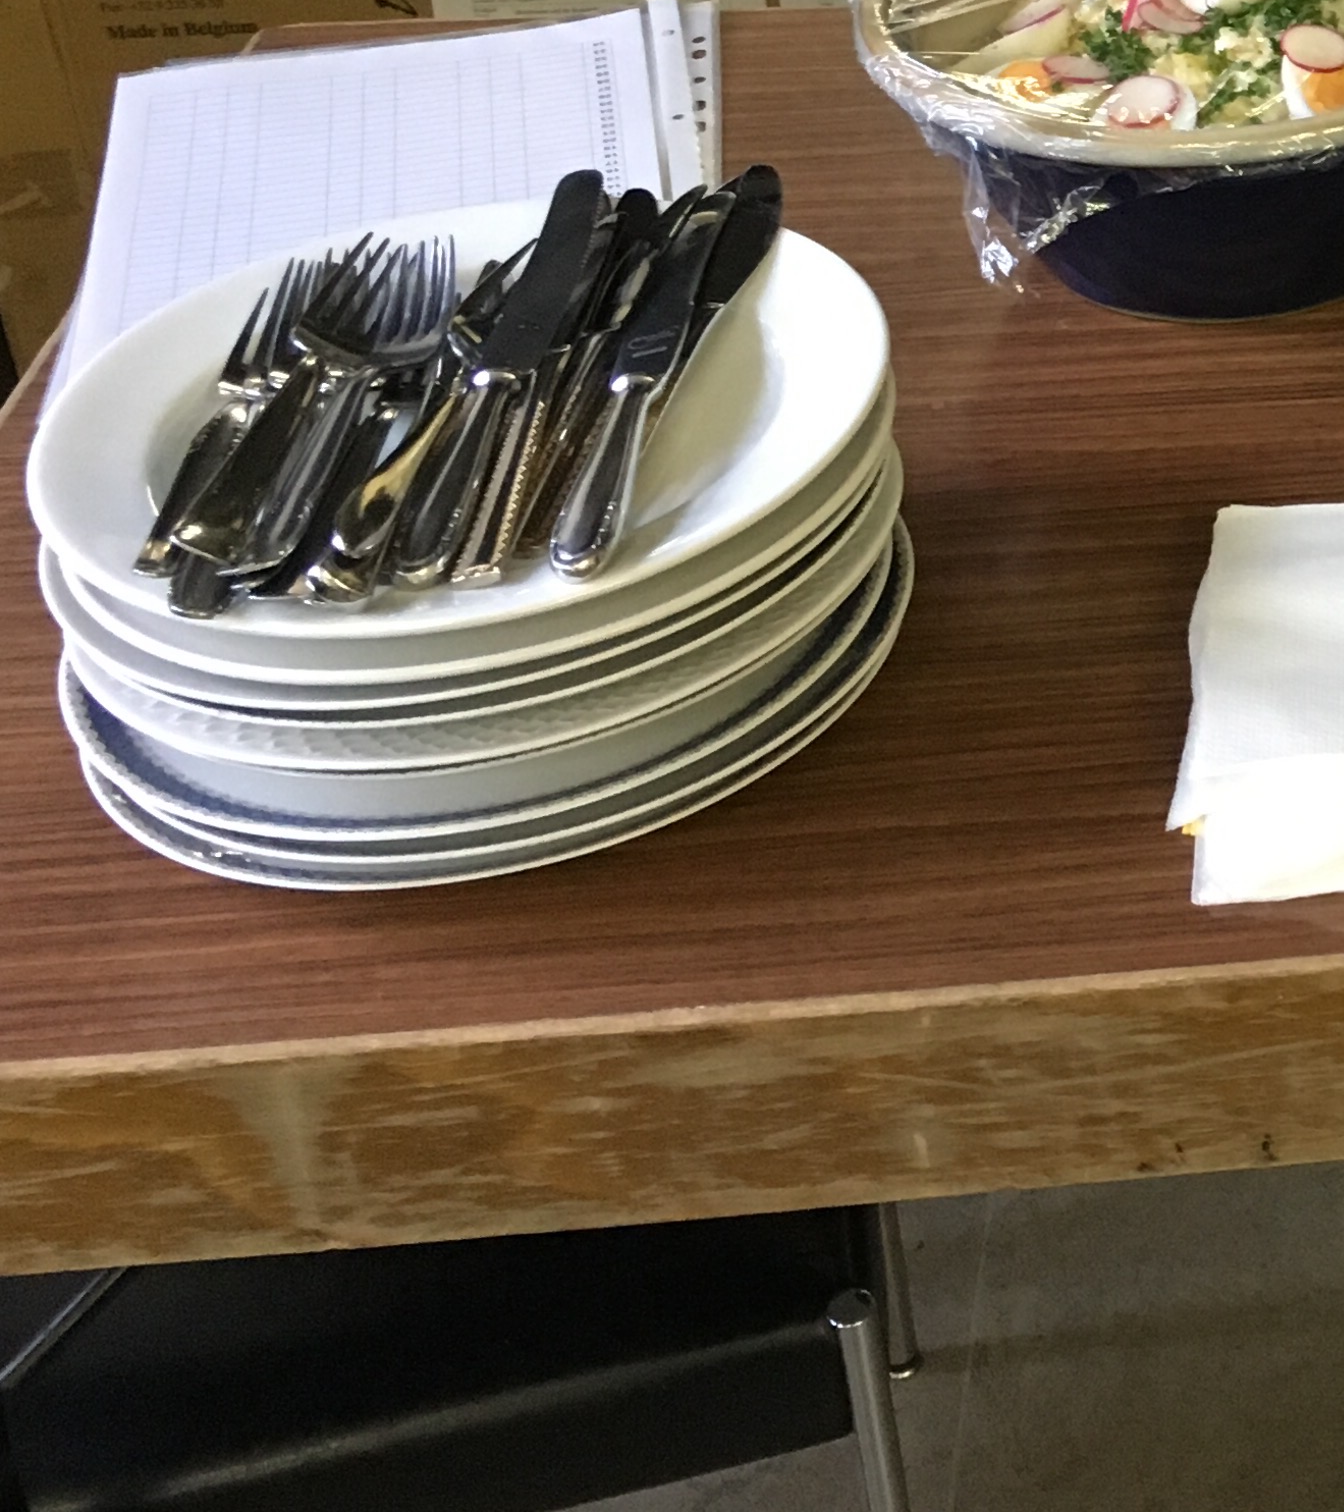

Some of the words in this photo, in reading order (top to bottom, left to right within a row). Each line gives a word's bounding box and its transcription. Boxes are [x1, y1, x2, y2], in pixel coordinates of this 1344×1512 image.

[106, 22, 156, 39] Made
[160, 22, 179, 37] in
[183, 20, 258, 38] Belgium
